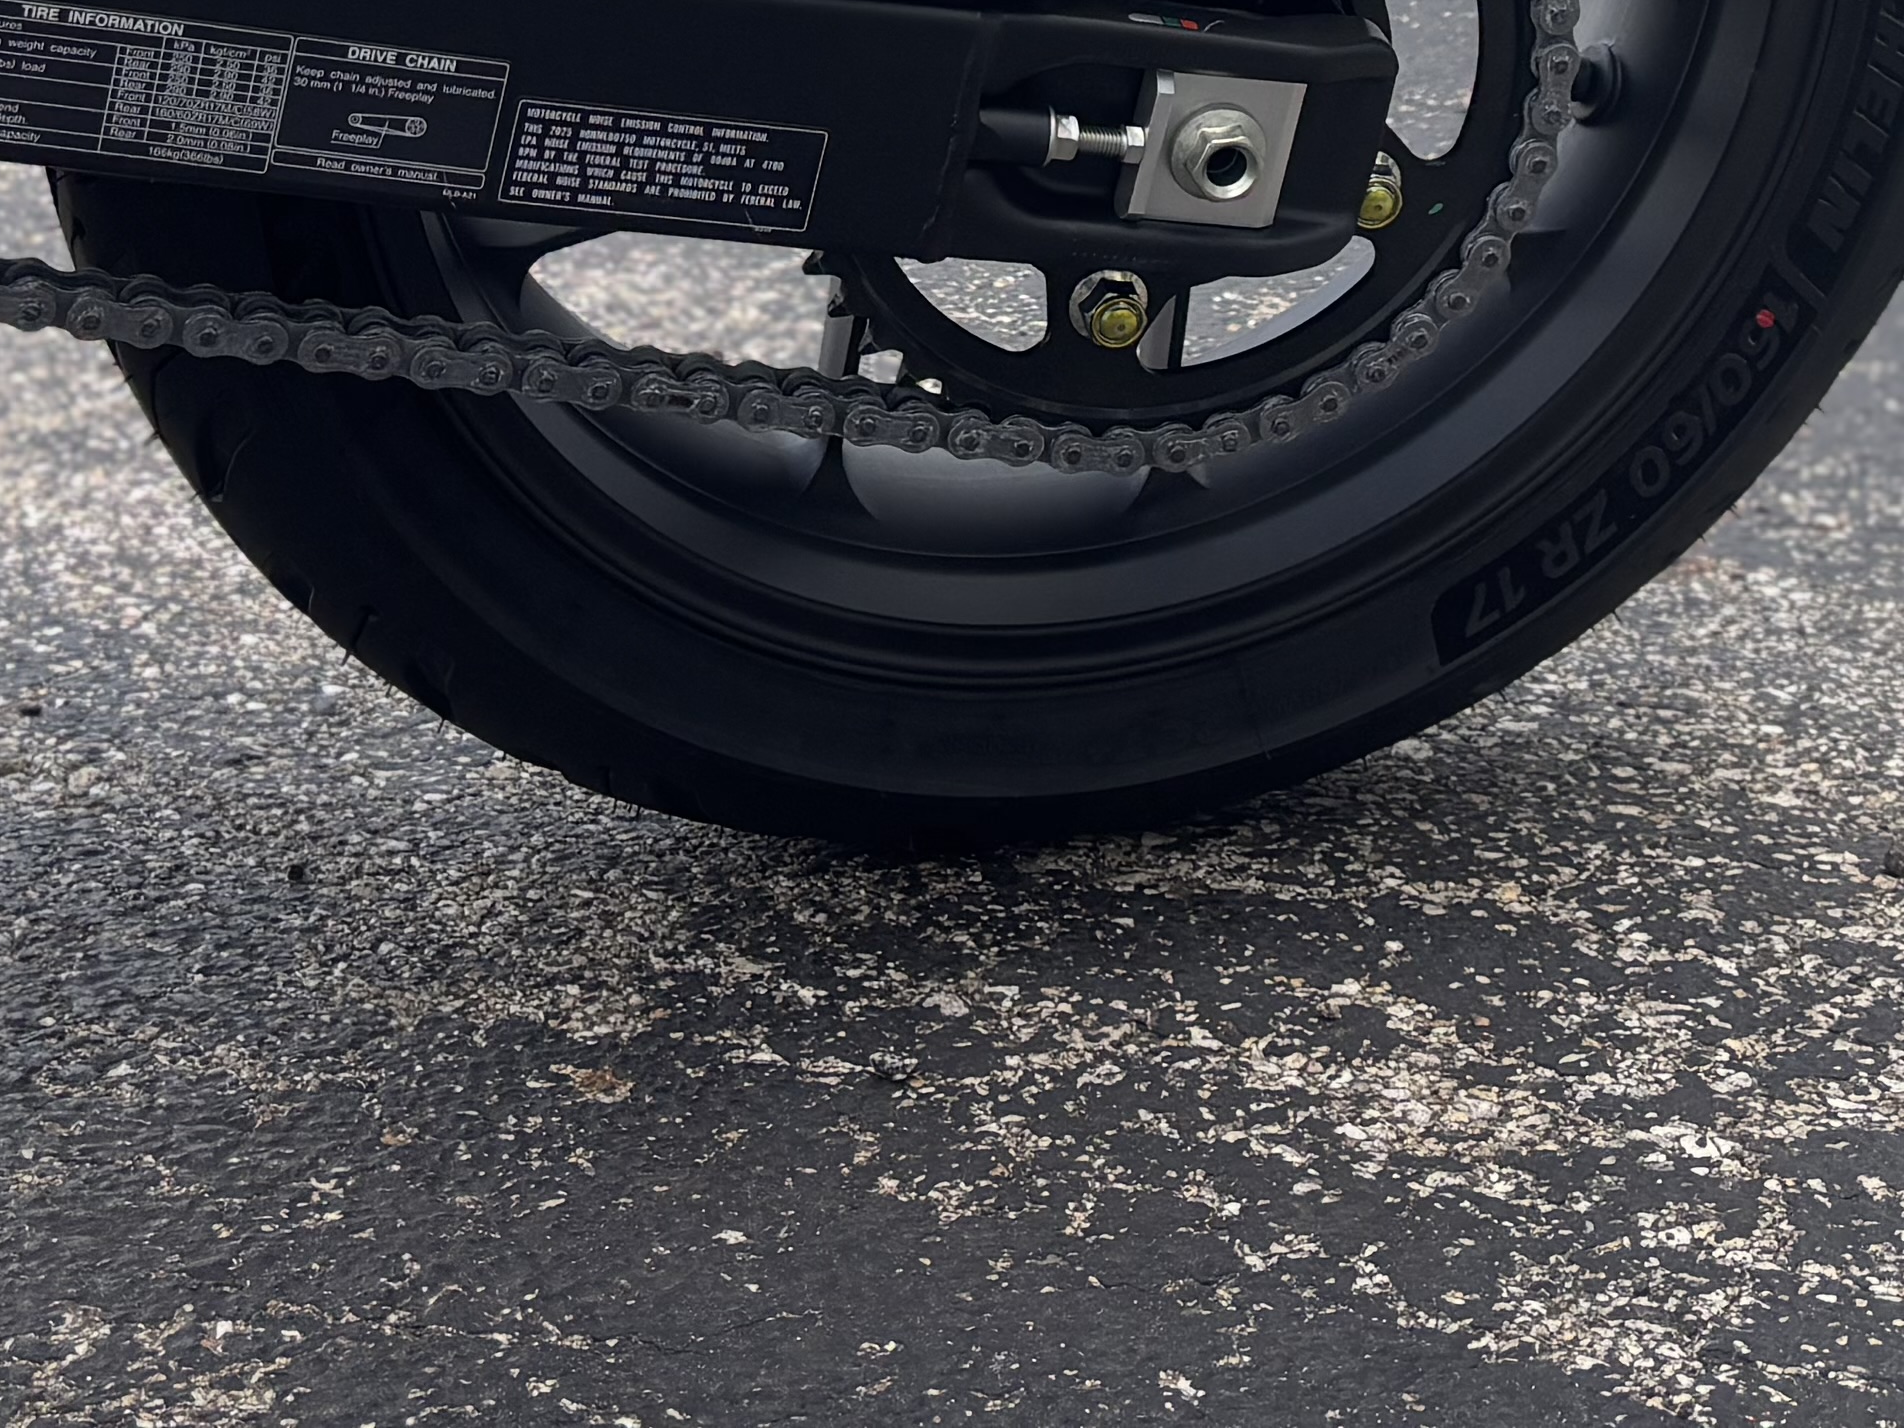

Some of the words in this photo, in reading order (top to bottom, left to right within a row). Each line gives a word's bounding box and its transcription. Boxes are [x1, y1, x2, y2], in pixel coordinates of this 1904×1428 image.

[22, 4, 60, 21] TIRE
[68, 10, 184, 36] INFORMATION
[8, 40, 45, 51] weight
[50, 44, 97, 59] capacity
[173, 40, 195, 52] kPa
[263, 54, 281, 63] psi
[21, 61, 46, 73] load
[347, 46, 398, 64] DRIVE
[405, 54, 457, 72] CHAIN
[293, 76, 308, 87] 30
[310, 80, 331, 89] mm
[351, 83, 366, 94] 1/4
[387, 88, 434, 104] Freeplay
[295, 65, 325, 78] Keep
[329, 70, 360, 82] chain
[365, 75, 412, 89] adjusted
[416, 82, 438, 92] and
[114, 101, 141, 114] Rear
[116, 89, 146, 102] Front
[109, 126, 136, 139] Rear
[112, 114, 141, 127] Front
[527, 108, 581, 122] MOTORCYCLE
[588, 114, 614, 126] NOISE
[620, 118, 661, 131] EMISSION
[667, 122, 704, 136] CONTROL
[331, 129, 378, 145] Freeplay
[524, 122, 543, 134] THIS
[549, 125, 572, 137] 2025
[719, 143, 746, 155] MEETS
[518, 146, 538, 158] RPM
[544, 149, 556, 160] BY
[563, 151, 578, 162] THE
[585, 154, 620, 167] FEDERAL
[629, 158, 649, 170] TEST
[521, 134, 537, 145] EPA
[544, 137, 569, 149] NOISE
[576, 141, 617, 154] EMISSION
[623, 146, 686, 162] REQUIREMENTS
[692, 153, 704, 163] OF
[744, 158, 755, 168] AT
[316, 157, 346, 170] Read
[350, 163, 392, 176] owner's
[515, 159, 579, 175] MODIFICATIONS
[586, 166, 614, 179] WHICH
[620, 170, 647, 182] CAUSE
[655, 173, 673, 185] THIS
[680, 176, 734, 191] MOTORCYCLE
[741, 182, 752, 193] TO
[758, 184, 789, 196] EXCEED
[509, 186, 525, 197] SEE
[532, 189, 571, 202] OWNER'S
[512, 171, 548, 184] FEDERAL
[556, 175, 581, 188] NOISE
[588, 178, 637, 193] STANDARDS
[644, 185, 661, 196] ARE
[668, 187, 716, 201] PROHIBITED
[722, 193, 735, 203] BY
[740, 194, 775, 207] FEDERAL
[1628, 291, 1799, 498] 160/60
[1537, 488, 1618, 579] ZR
[1464, 566, 1526, 638] 17
